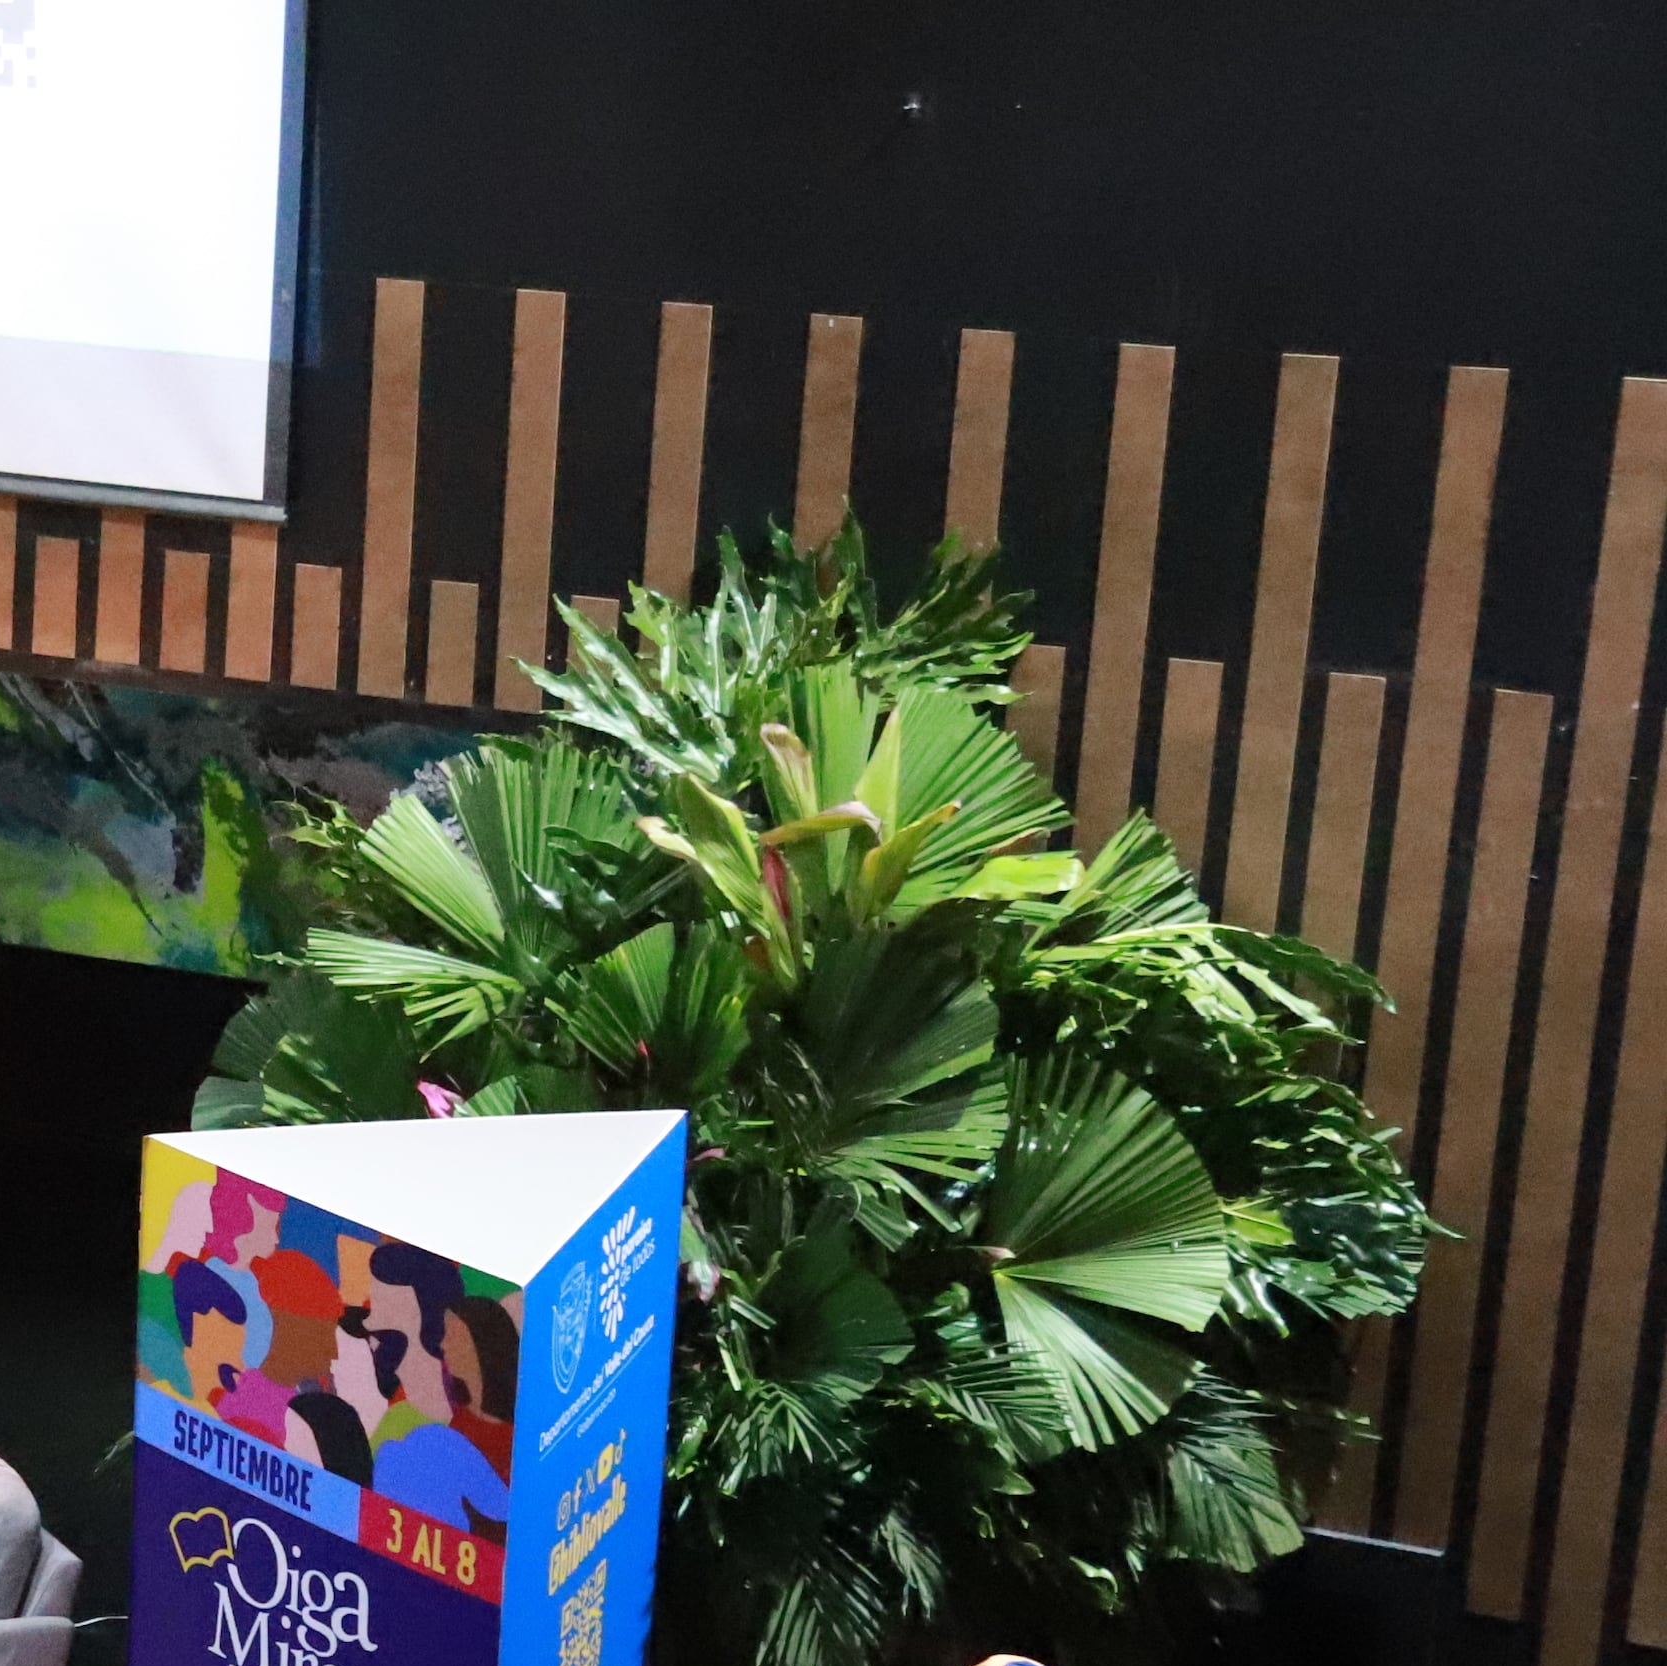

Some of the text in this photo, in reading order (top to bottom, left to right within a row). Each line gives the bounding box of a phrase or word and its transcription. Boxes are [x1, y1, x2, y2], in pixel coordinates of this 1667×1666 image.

[174, 1410, 313, 1511] SEPTIEMBRE
[227, 1518, 378, 1657] Oiga
[387, 1508, 476, 1585] 3 AL 8
